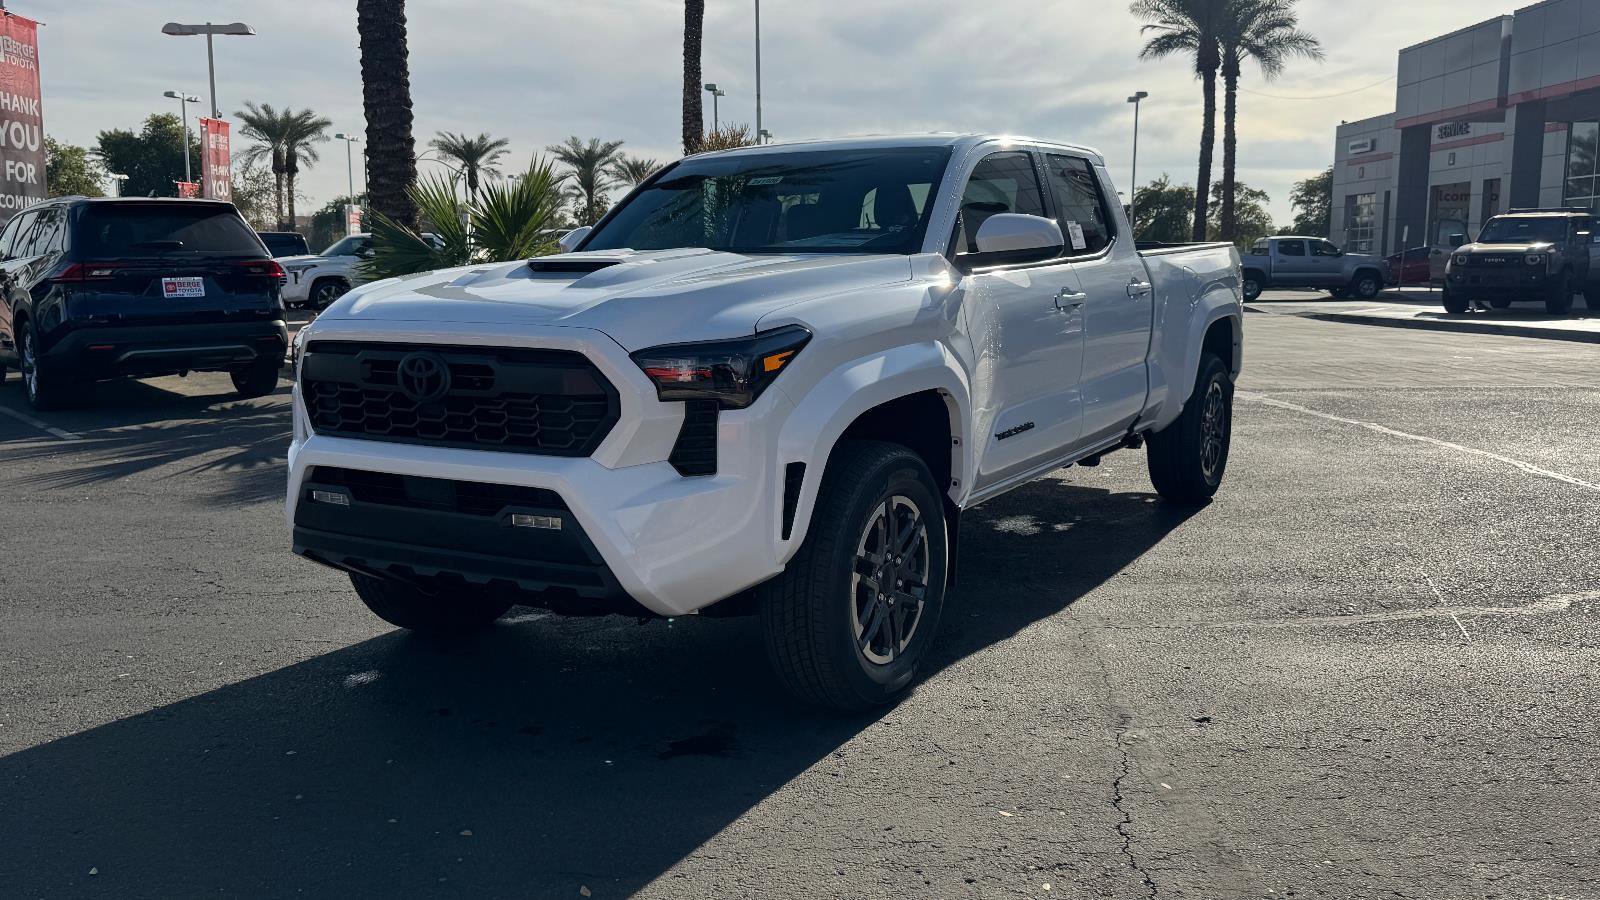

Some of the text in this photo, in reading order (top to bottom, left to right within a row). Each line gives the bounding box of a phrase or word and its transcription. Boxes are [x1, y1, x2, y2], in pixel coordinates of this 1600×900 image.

[4, 36, 35, 58] BERGE
[5, 54, 35, 71] TOYOTA
[0, 91, 40, 117] HANK
[0, 120, 40, 152] YOU
[1438, 121, 1471, 139] SERVICE
[5, 159, 38, 185] FOR
[211, 179, 229, 196] YOU
